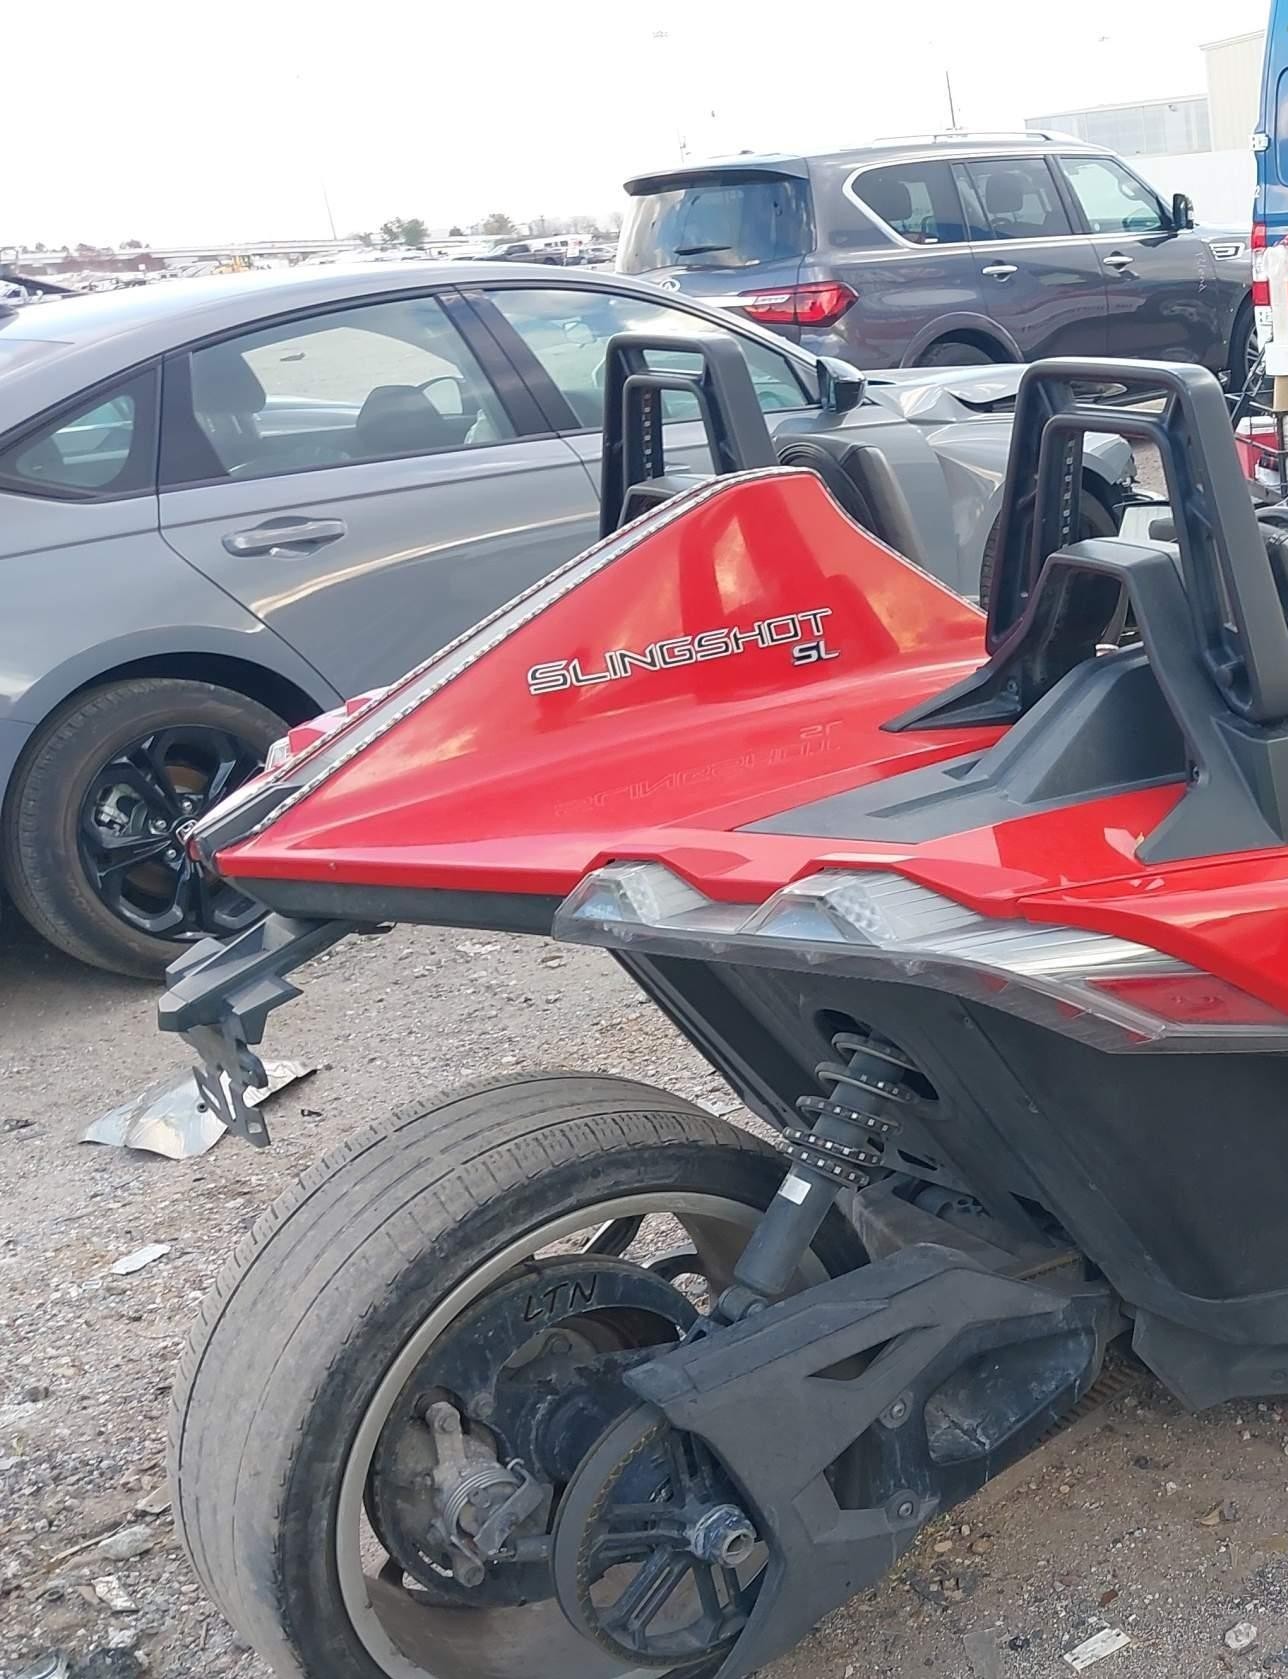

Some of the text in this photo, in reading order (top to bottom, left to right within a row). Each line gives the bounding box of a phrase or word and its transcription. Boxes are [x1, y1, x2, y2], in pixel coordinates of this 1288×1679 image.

[527, 607, 833, 695] SLINGSHOT
[791, 639, 842, 666] SL
[523, 1273, 598, 1322] LTN
